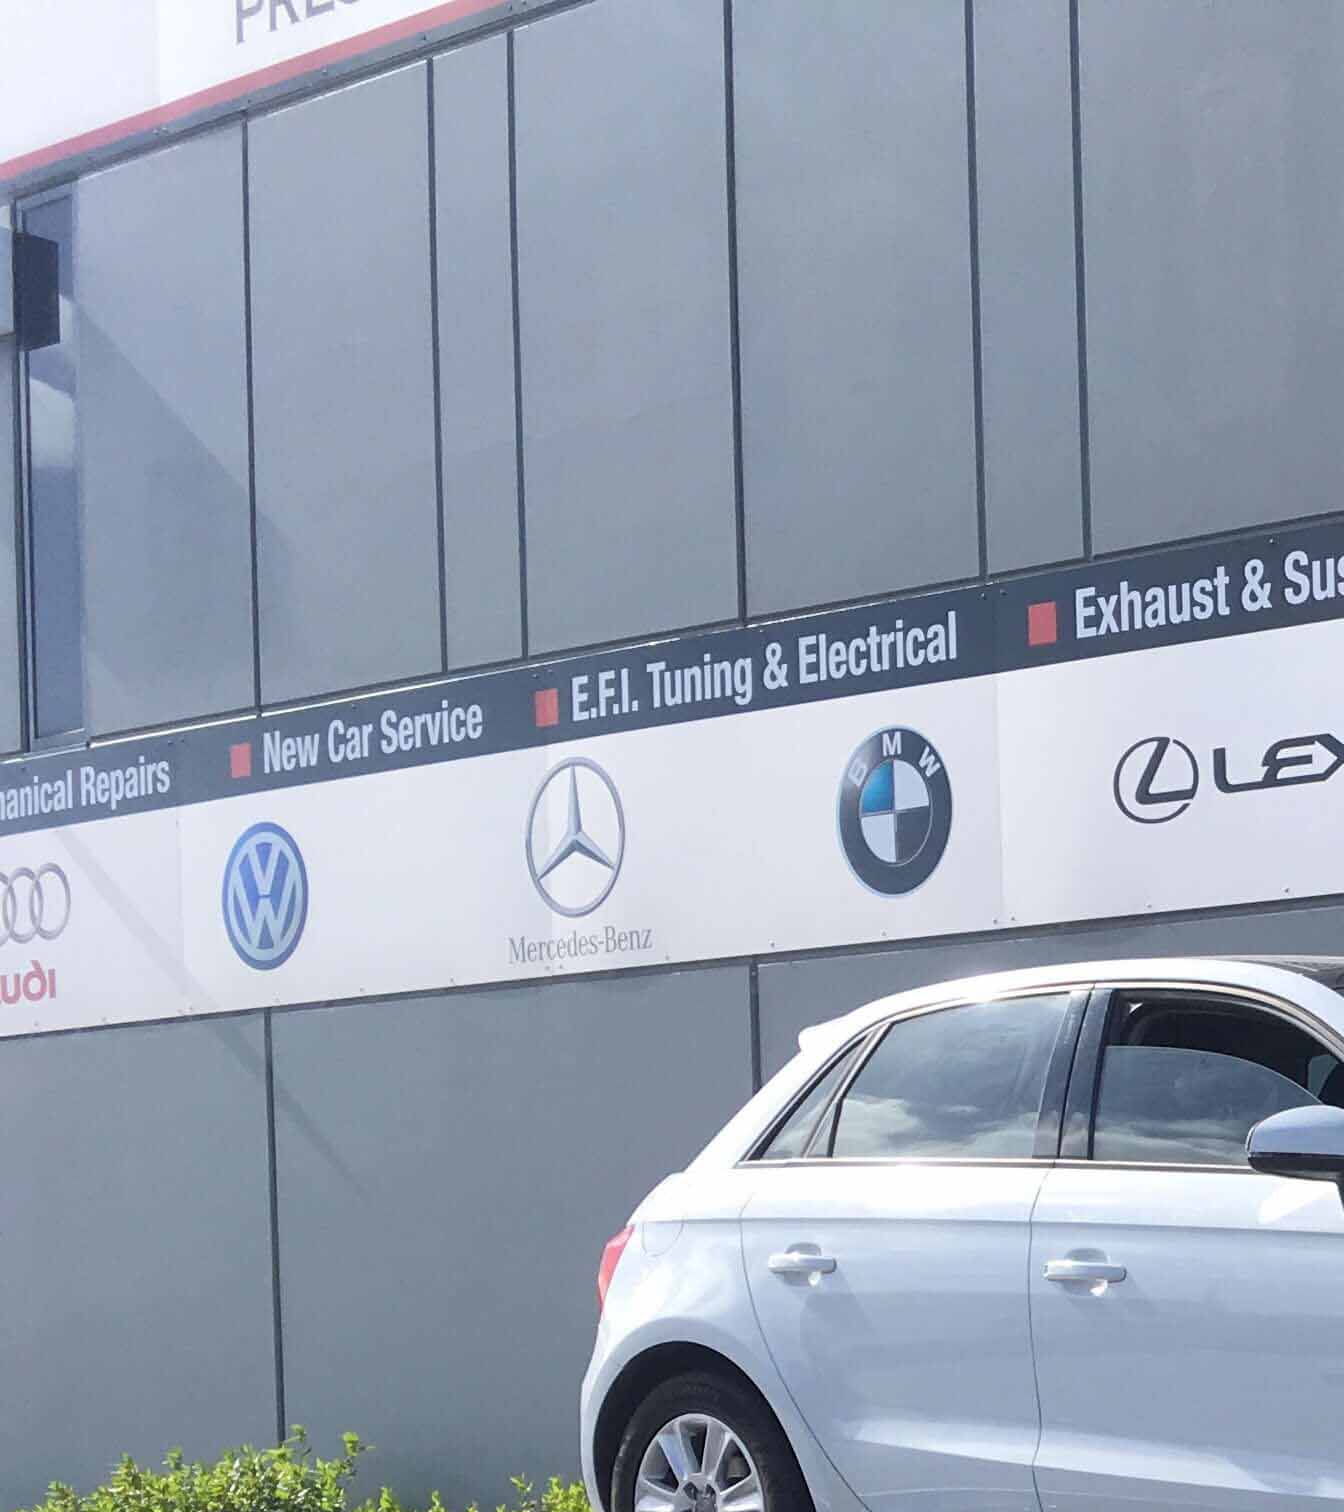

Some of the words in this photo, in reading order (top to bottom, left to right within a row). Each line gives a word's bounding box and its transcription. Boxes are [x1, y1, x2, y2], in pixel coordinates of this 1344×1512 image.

[1075, 565, 1230, 640] Exhaust
[1242, 558, 1273, 612] &
[571, 666, 639, 722] E.F.I.
[646, 654, 753, 708] Tuning
[763, 642, 789, 690] &
[798, 611, 957, 685] Electrical
[263, 729, 319, 774] New
[327, 716, 372, 762] Car
[380, 700, 484, 754] Service
[0, 769, 73, 821] anical
[80, 755, 171, 811] Repairs
[507, 925, 654, 965] Mercedes-Benz
[0, 959, 57, 1005] udi
